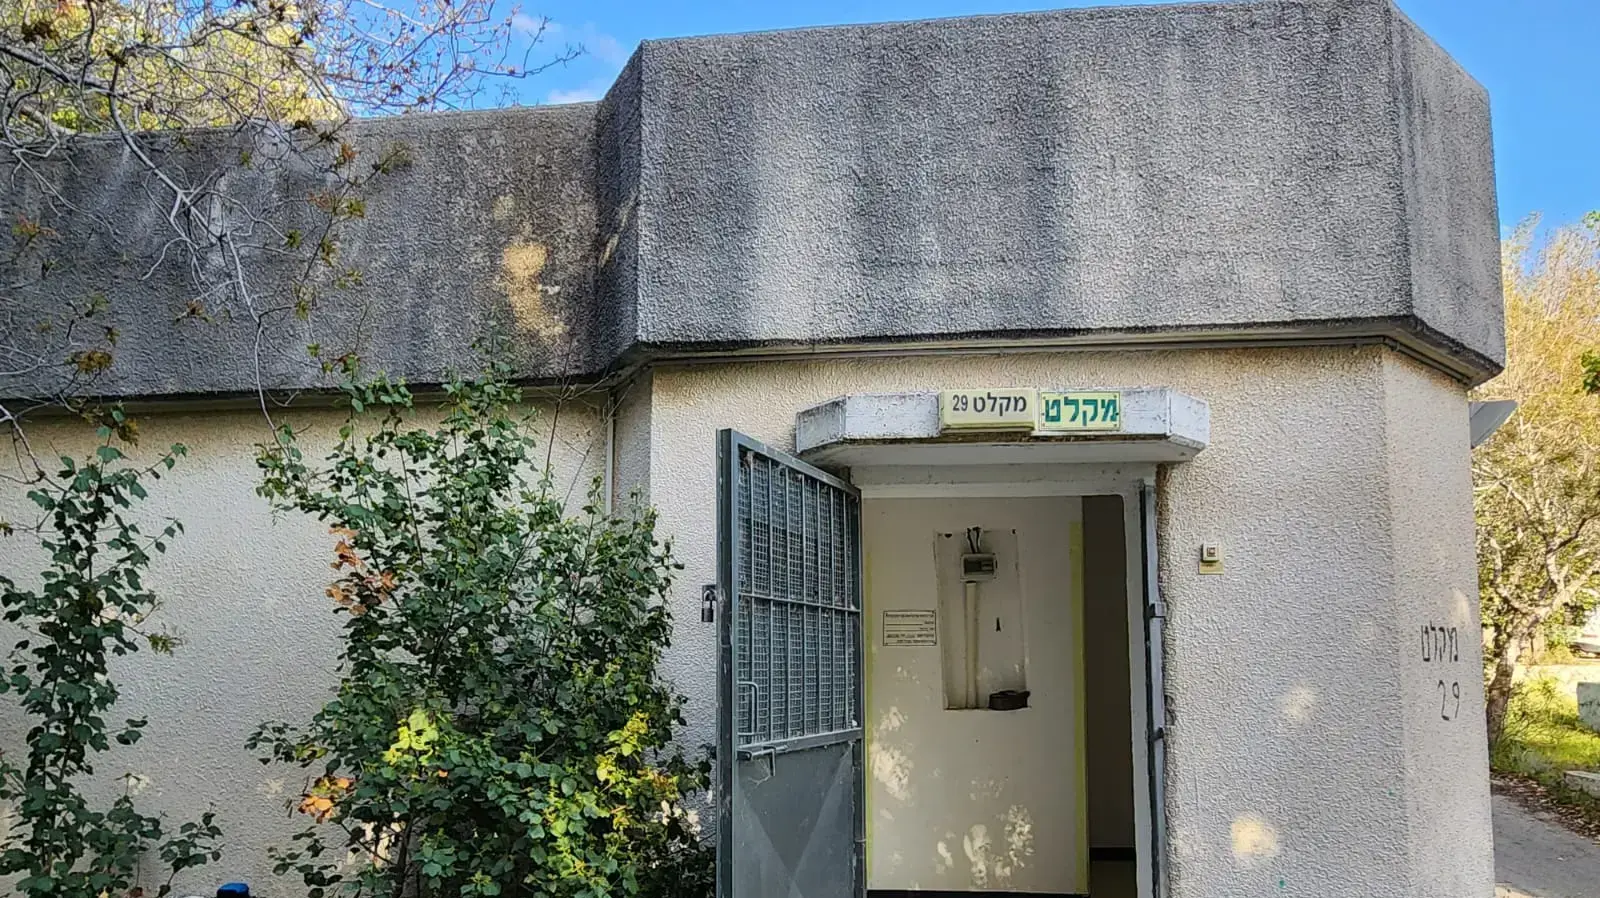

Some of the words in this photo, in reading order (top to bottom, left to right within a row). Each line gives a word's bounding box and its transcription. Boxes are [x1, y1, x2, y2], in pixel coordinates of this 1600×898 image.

[952, 394, 968, 412] 29
[973, 392, 1027, 417] מקלט
[1044, 396, 1119, 427] מקלט
[1420, 620, 1459, 663] מקלט
[1437, 680, 1460, 721] 29
